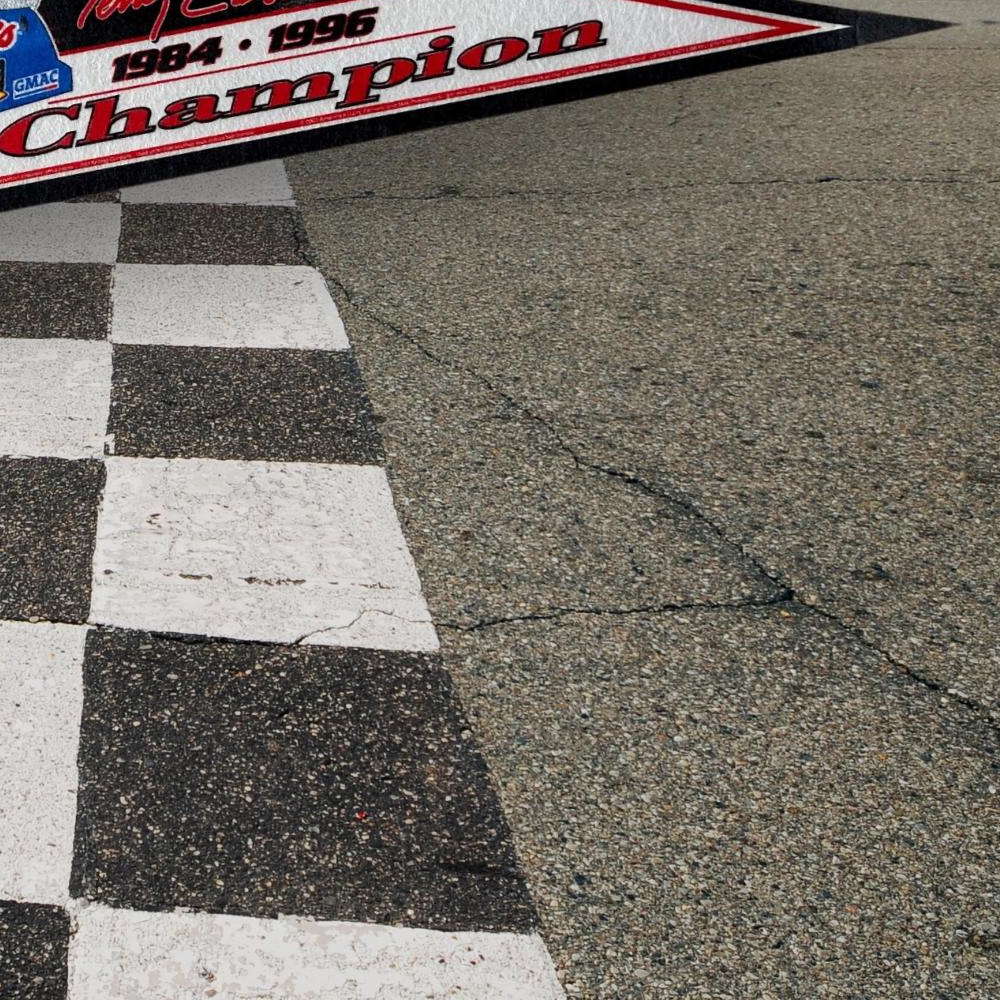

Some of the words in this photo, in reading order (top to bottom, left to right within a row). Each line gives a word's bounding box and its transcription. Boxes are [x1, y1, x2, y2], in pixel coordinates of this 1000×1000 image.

[111, 35, 224, 83] 1984
[267, 6, 380, 54] 1996
[14, 70, 58, 92] GMAC
